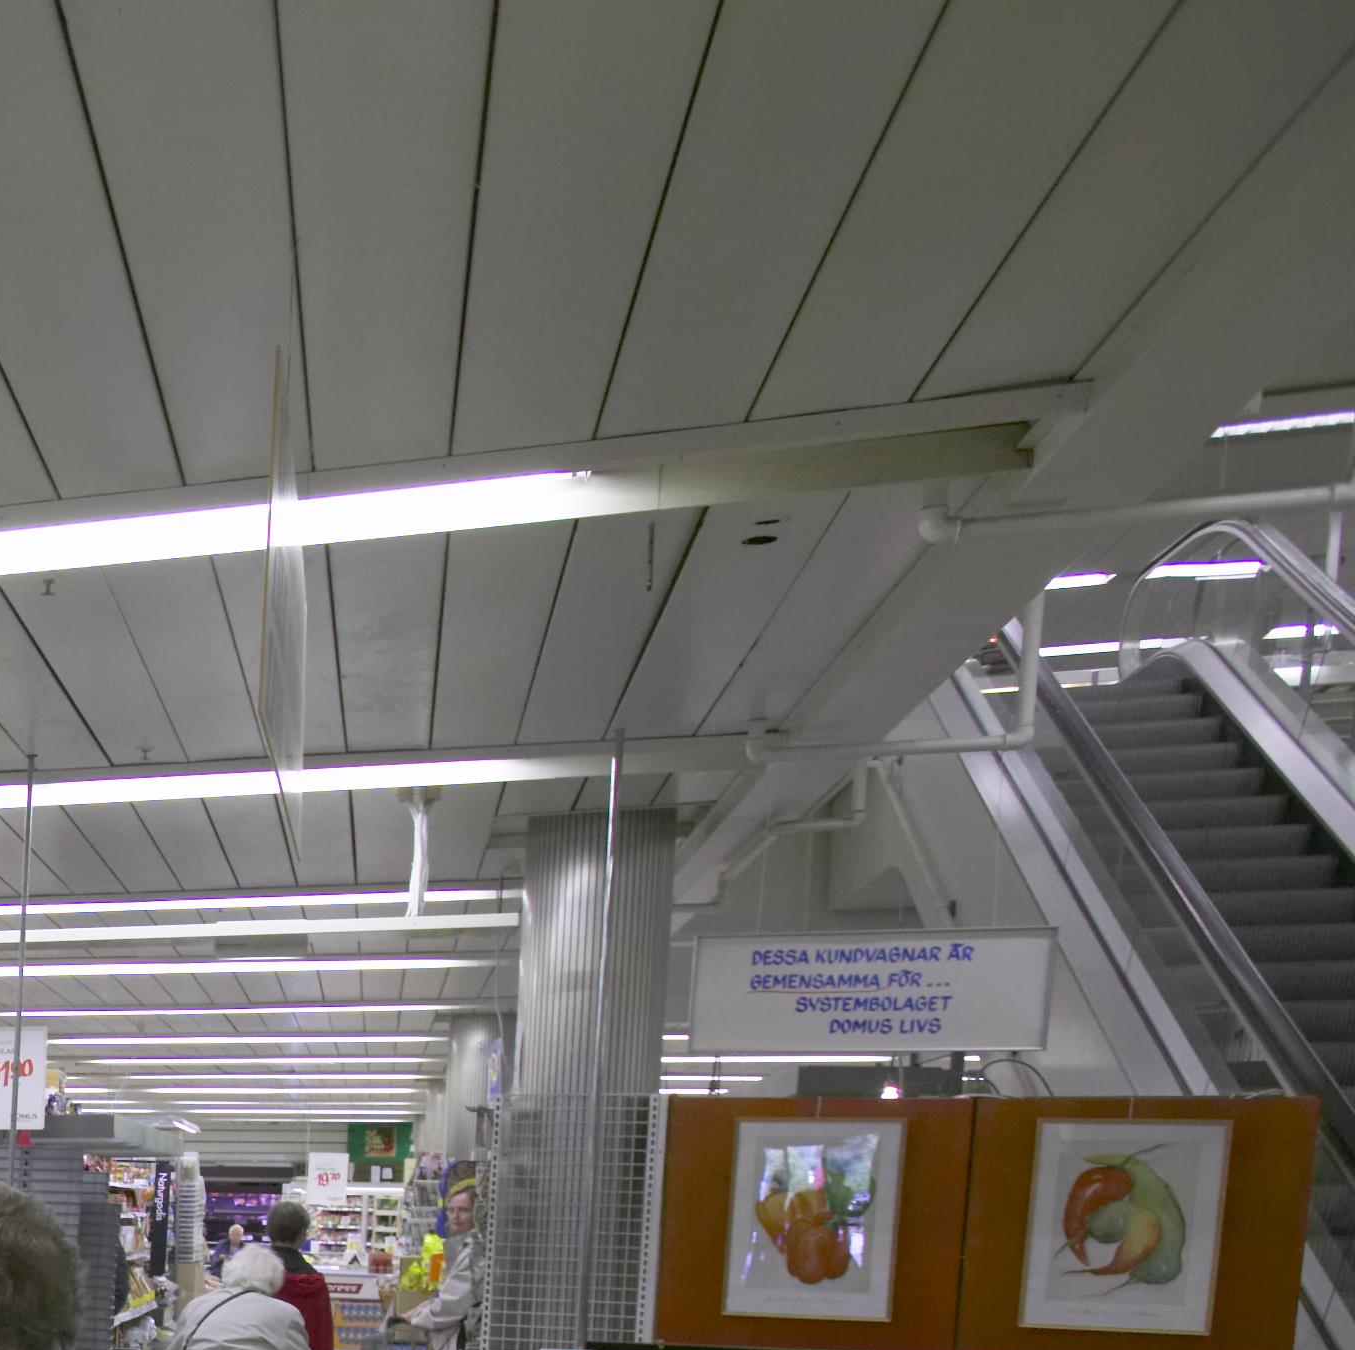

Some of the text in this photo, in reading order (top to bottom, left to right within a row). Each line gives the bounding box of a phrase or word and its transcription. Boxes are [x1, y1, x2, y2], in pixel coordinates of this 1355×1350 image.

[751, 943, 974, 966] DESSA KUNDVAGNAR ÄR
[750, 973, 880, 990] GEMENSAMMA
[887, 969, 922, 988] FÖR
[795, 996, 953, 1013] SYSTEMBOLAGET
[829, 1018, 942, 1035] DOMUS LIVS
